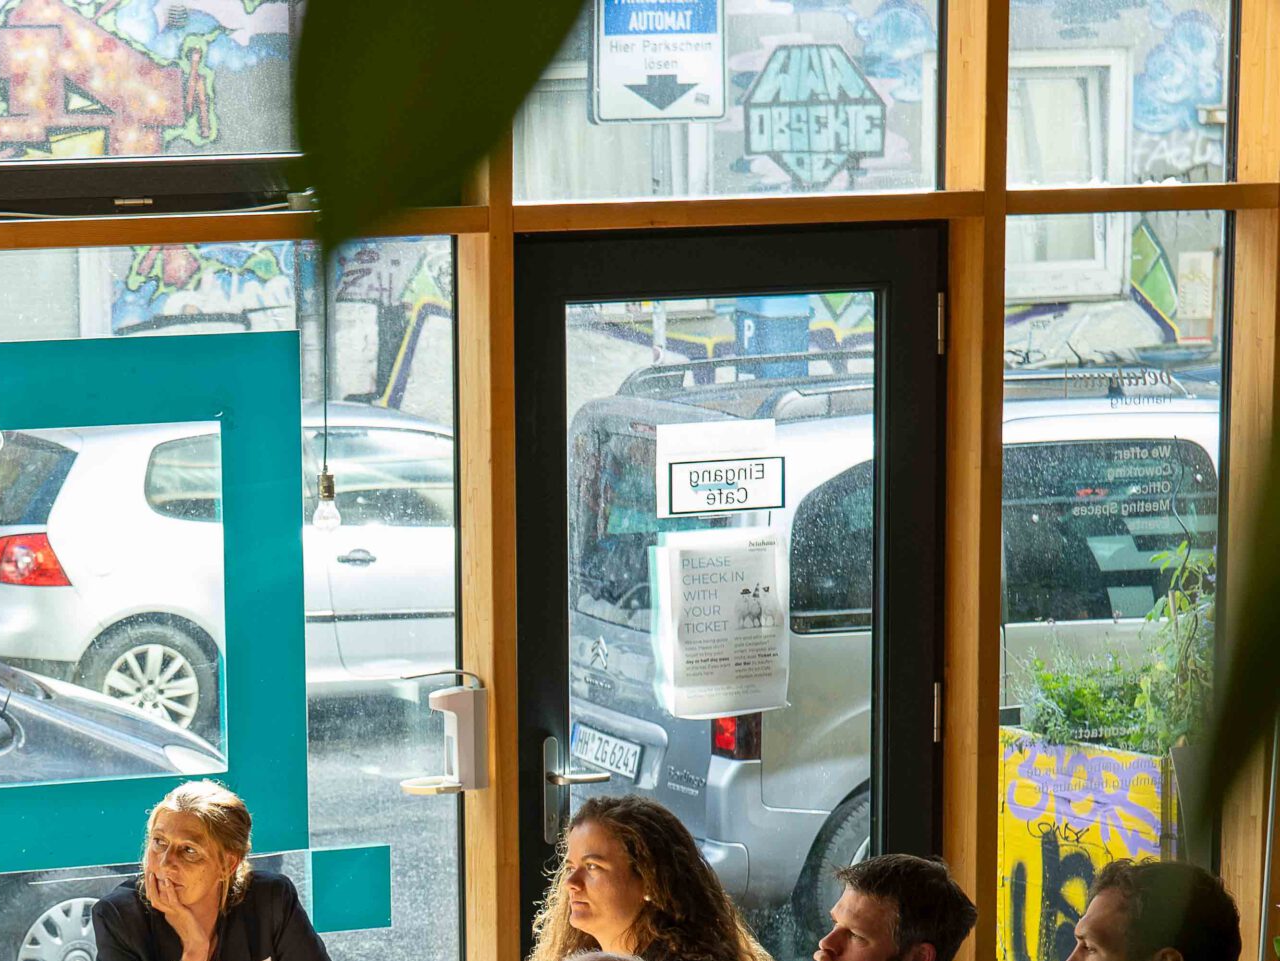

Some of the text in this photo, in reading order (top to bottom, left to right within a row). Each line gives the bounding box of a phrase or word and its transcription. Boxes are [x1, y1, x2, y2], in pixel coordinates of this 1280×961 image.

[628, 10, 692, 31] AUTOMAT
[610, 39, 712, 53] Hier Parkschein
[744, 319, 756, 350] P
[682, 556, 731, 570] PLEASE
[682, 571, 745, 586] CHECK IN
[683, 589, 719, 602] WITH
[684, 605, 721, 618] YOUR
[684, 620, 729, 635] TICKET
[575, 727, 638, 775] HH ZG 6241
